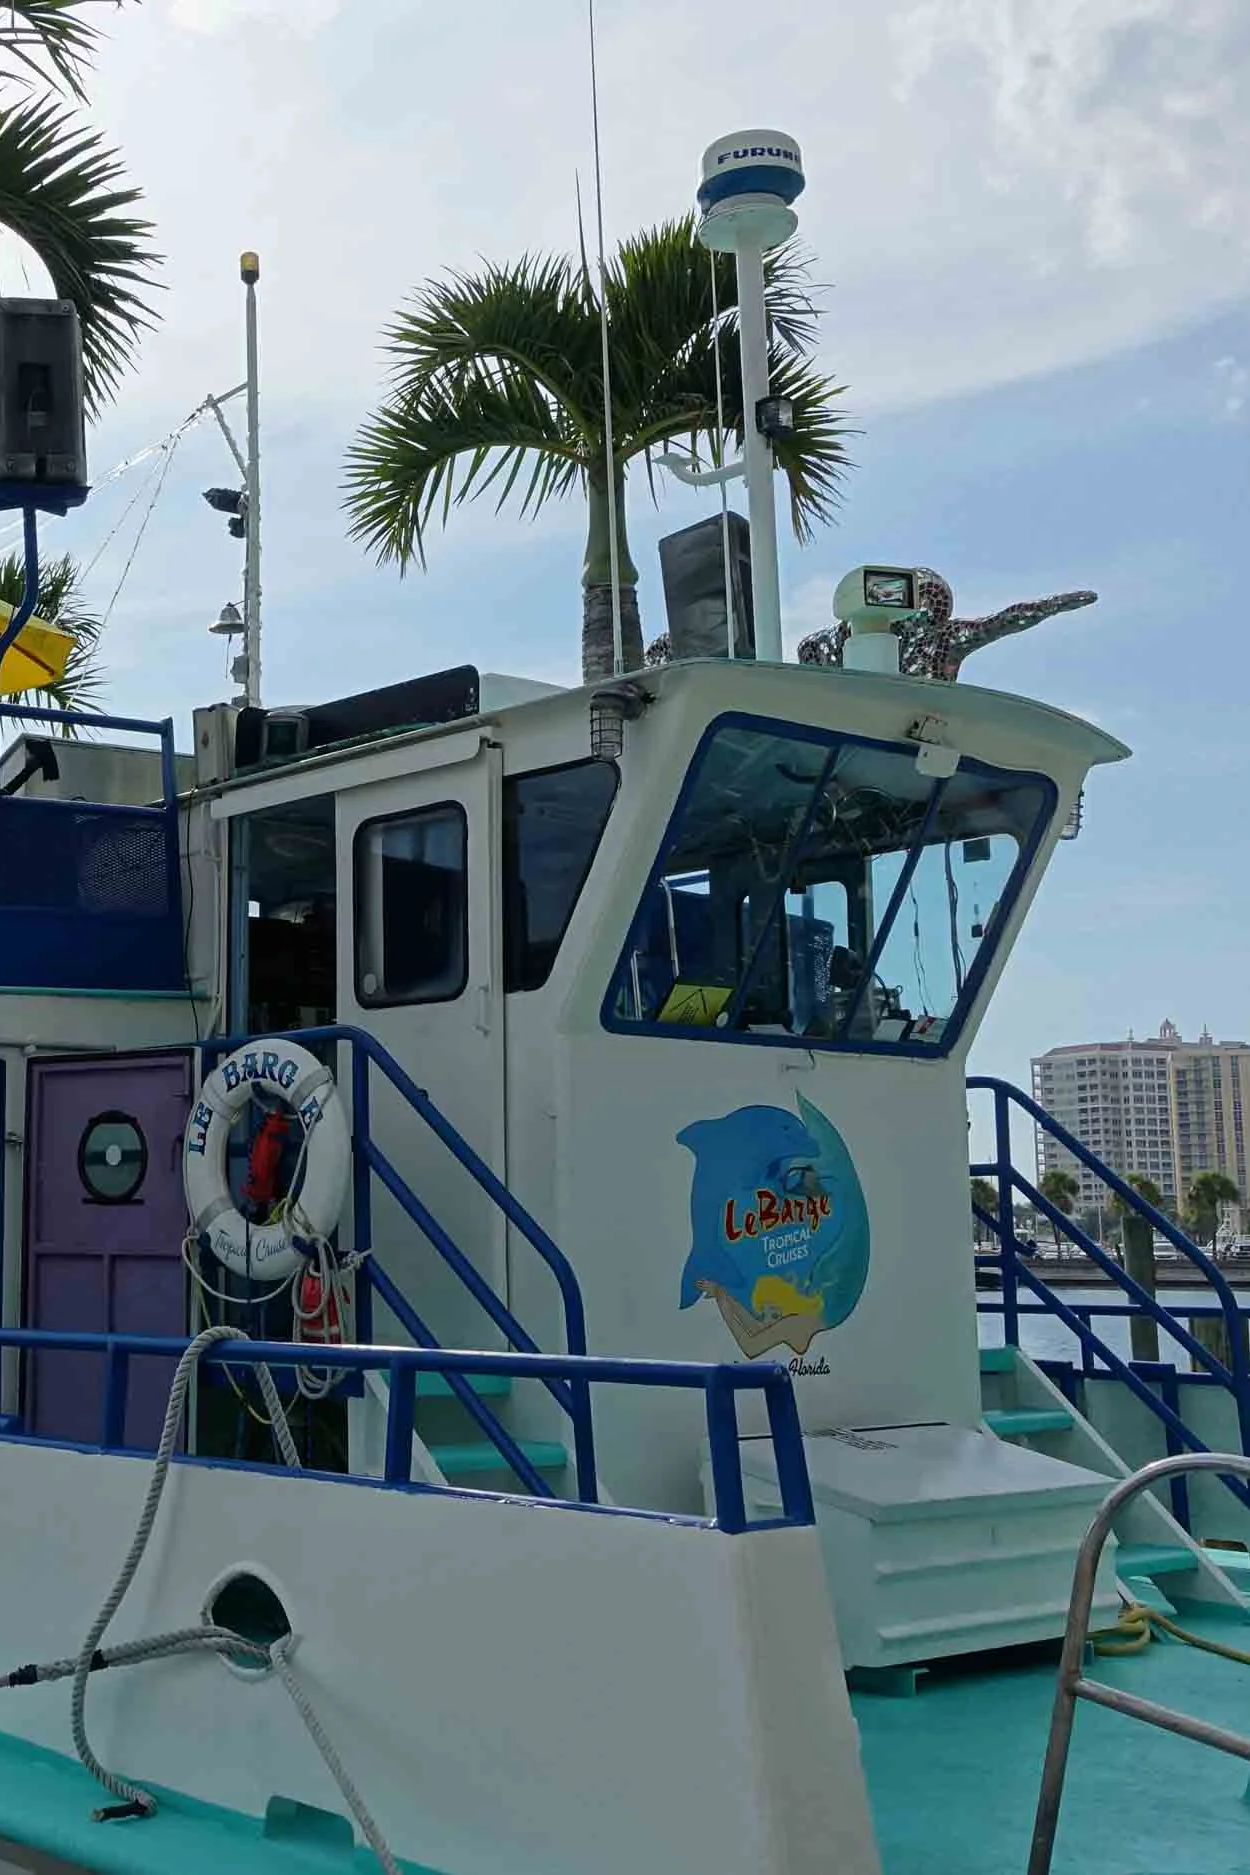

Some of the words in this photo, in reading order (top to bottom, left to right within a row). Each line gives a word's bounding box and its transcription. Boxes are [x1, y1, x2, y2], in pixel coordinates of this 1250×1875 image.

[189, 1101, 213, 1156] LE
[725, 1188, 831, 1241] LeBarge
[762, 1229, 812, 1252] TROPICAL
[766, 1244, 809, 1269] CRUISES
[788, 1356, 831, 1377] Florida
